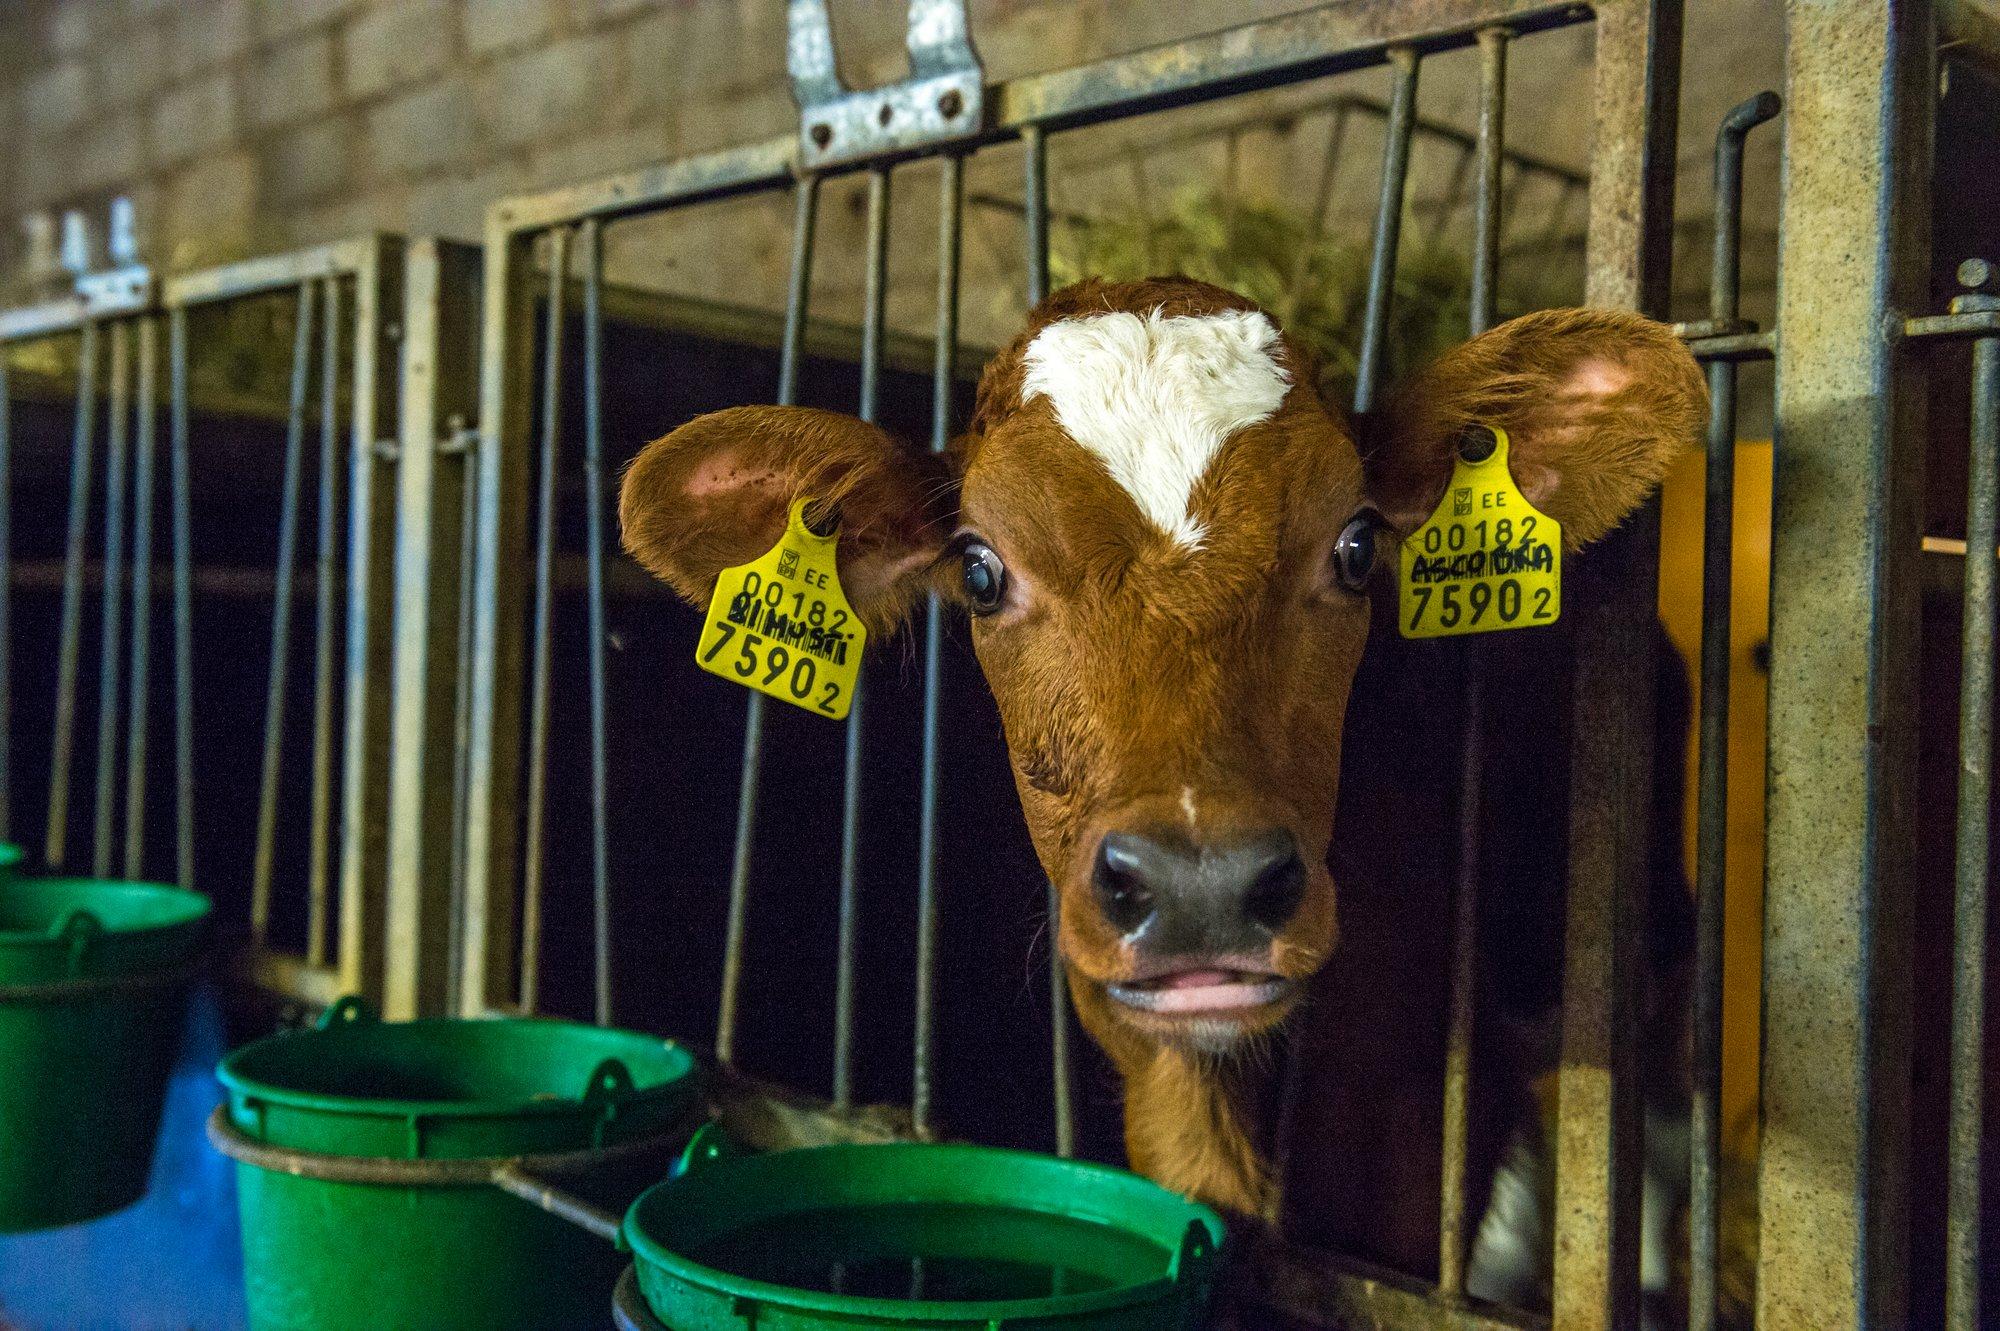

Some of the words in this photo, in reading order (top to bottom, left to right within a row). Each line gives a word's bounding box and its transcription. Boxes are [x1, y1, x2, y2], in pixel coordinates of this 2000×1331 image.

[1482, 491, 1507, 509] EE
[1424, 516, 1537, 554] 00182
[804, 568, 830, 591] EE
[743, 571, 848, 639] 00182
